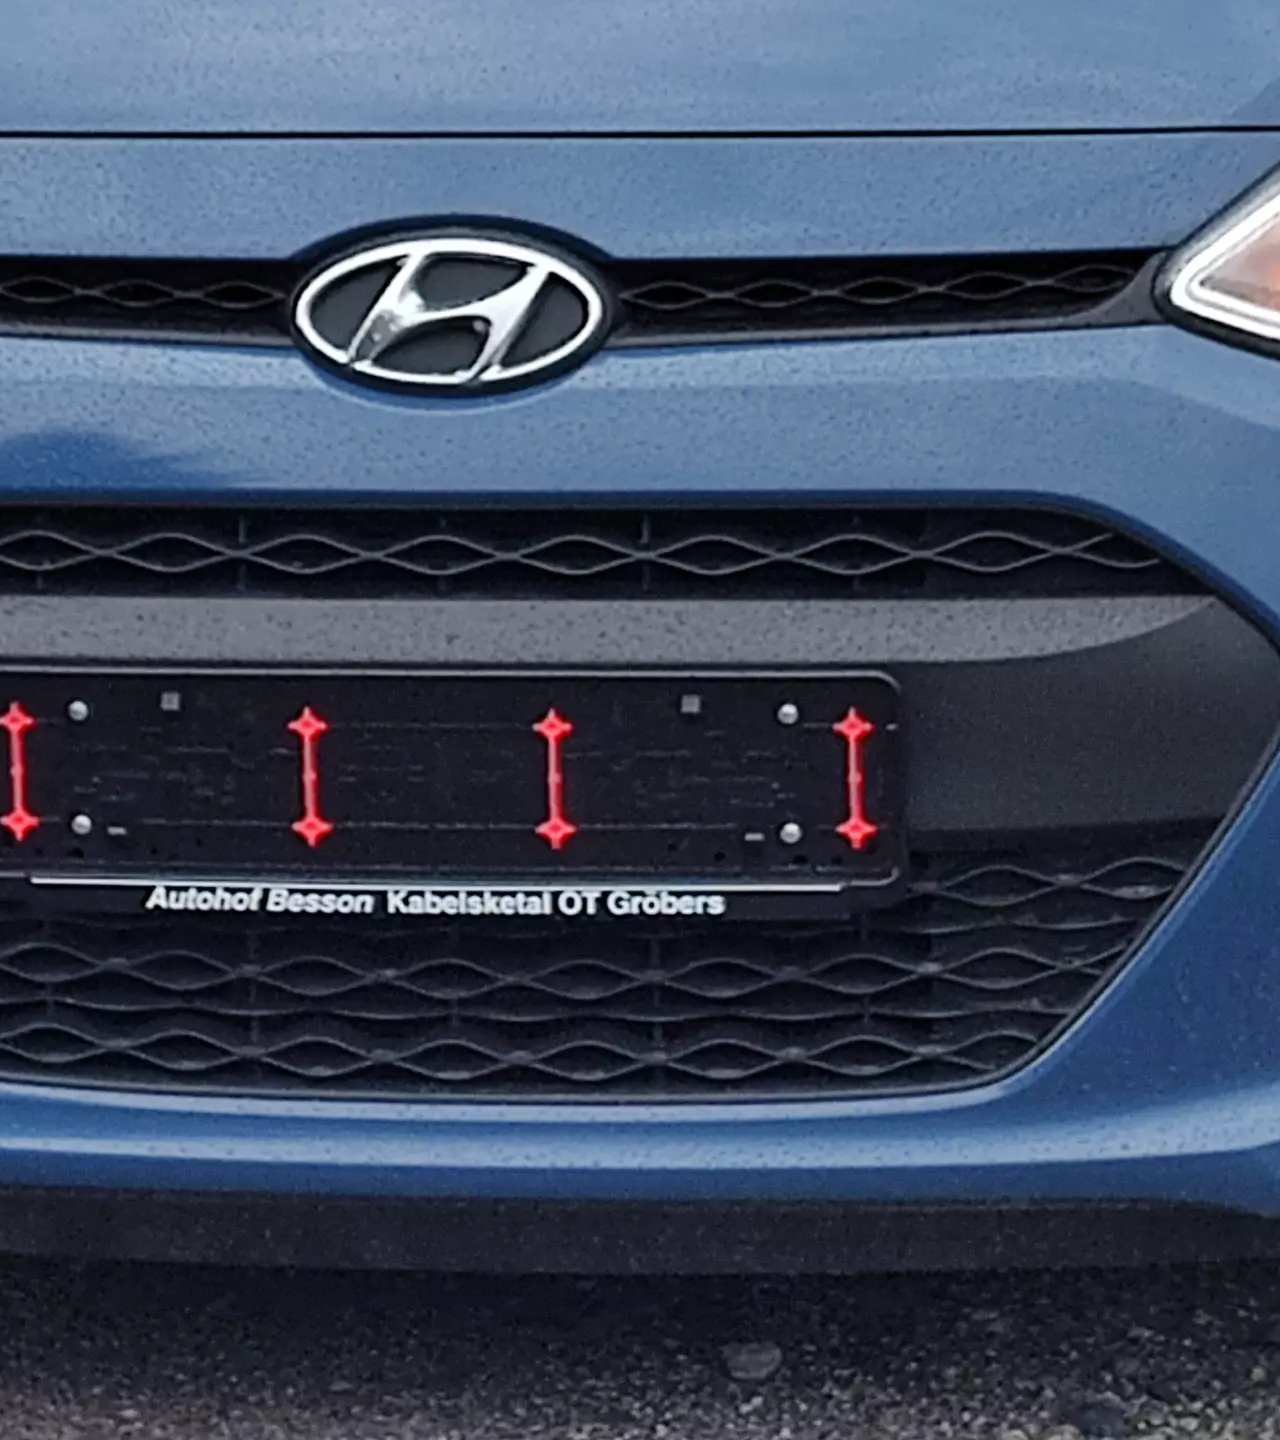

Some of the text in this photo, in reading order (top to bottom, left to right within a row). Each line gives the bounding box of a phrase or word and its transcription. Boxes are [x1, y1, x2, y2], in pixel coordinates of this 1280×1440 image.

[145, 886, 726, 916] Autohof Besson Kabelsketal OT Gröbers
